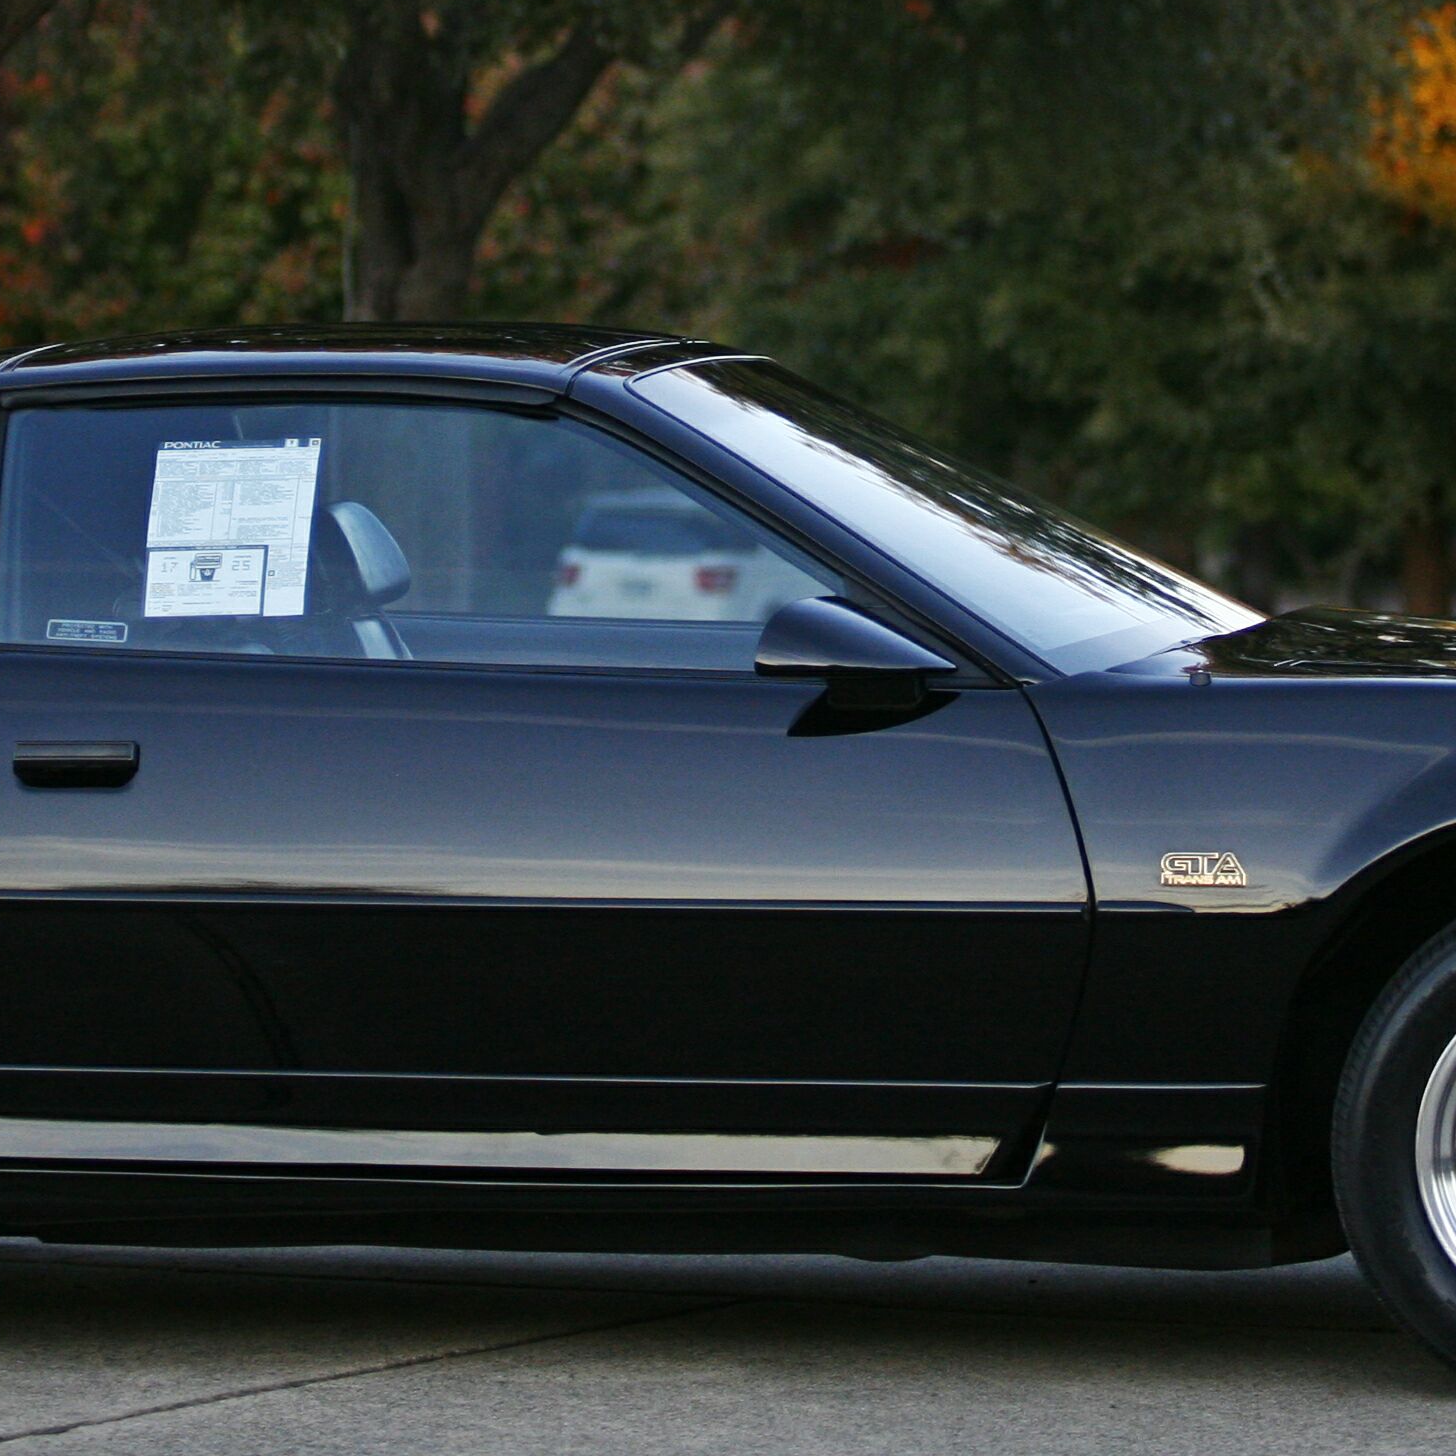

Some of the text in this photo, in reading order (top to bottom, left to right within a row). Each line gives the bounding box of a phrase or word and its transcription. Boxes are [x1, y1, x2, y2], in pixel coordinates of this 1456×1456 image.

[164, 440, 222, 449] PONTIAC
[231, 560, 250, 571] 25
[1161, 852, 1246, 876] GTA
[1165, 875, 1242, 884] TRANS AM
